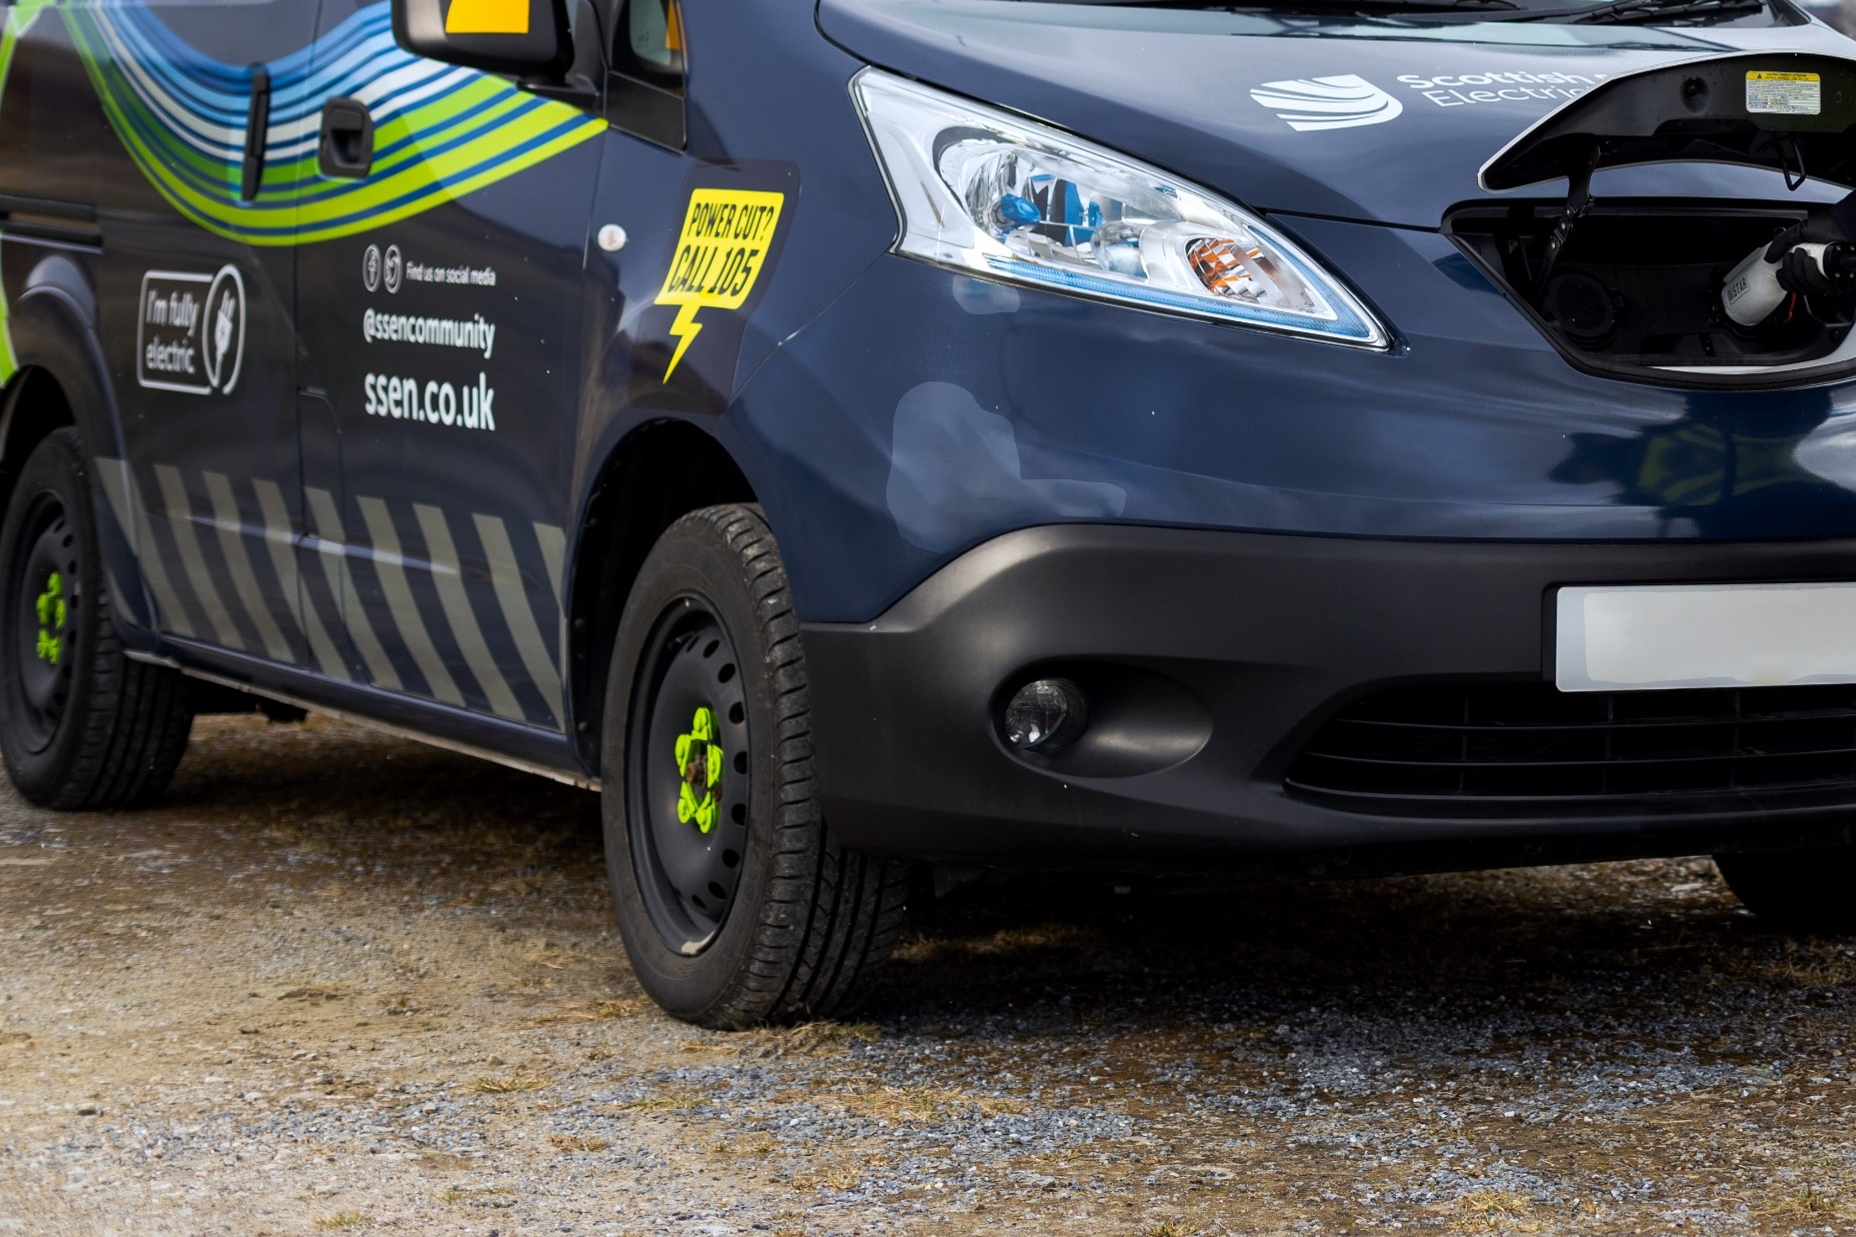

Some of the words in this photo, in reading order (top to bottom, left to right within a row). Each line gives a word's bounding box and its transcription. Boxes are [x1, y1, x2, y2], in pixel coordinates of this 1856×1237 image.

[1397, 70, 1596, 90] Scottish
[1421, 85, 1591, 108] Electric
[686, 202, 737, 239] POWER
[733, 203, 775, 241] CUT?
[405, 261, 423, 281] Find
[424, 265, 434, 281] us
[434, 266, 446, 284] on
[445, 264, 470, 284] social
[470, 267, 497, 287] media
[667, 244, 719, 294] CALL
[706, 246, 760, 297] 105
[146, 289, 169, 325] I'm
[168, 289, 200, 338] fully
[363, 307, 496, 360] @ssencommunity
[145, 335, 196, 375] electric
[364, 372, 496, 431] ssen.co.uk
